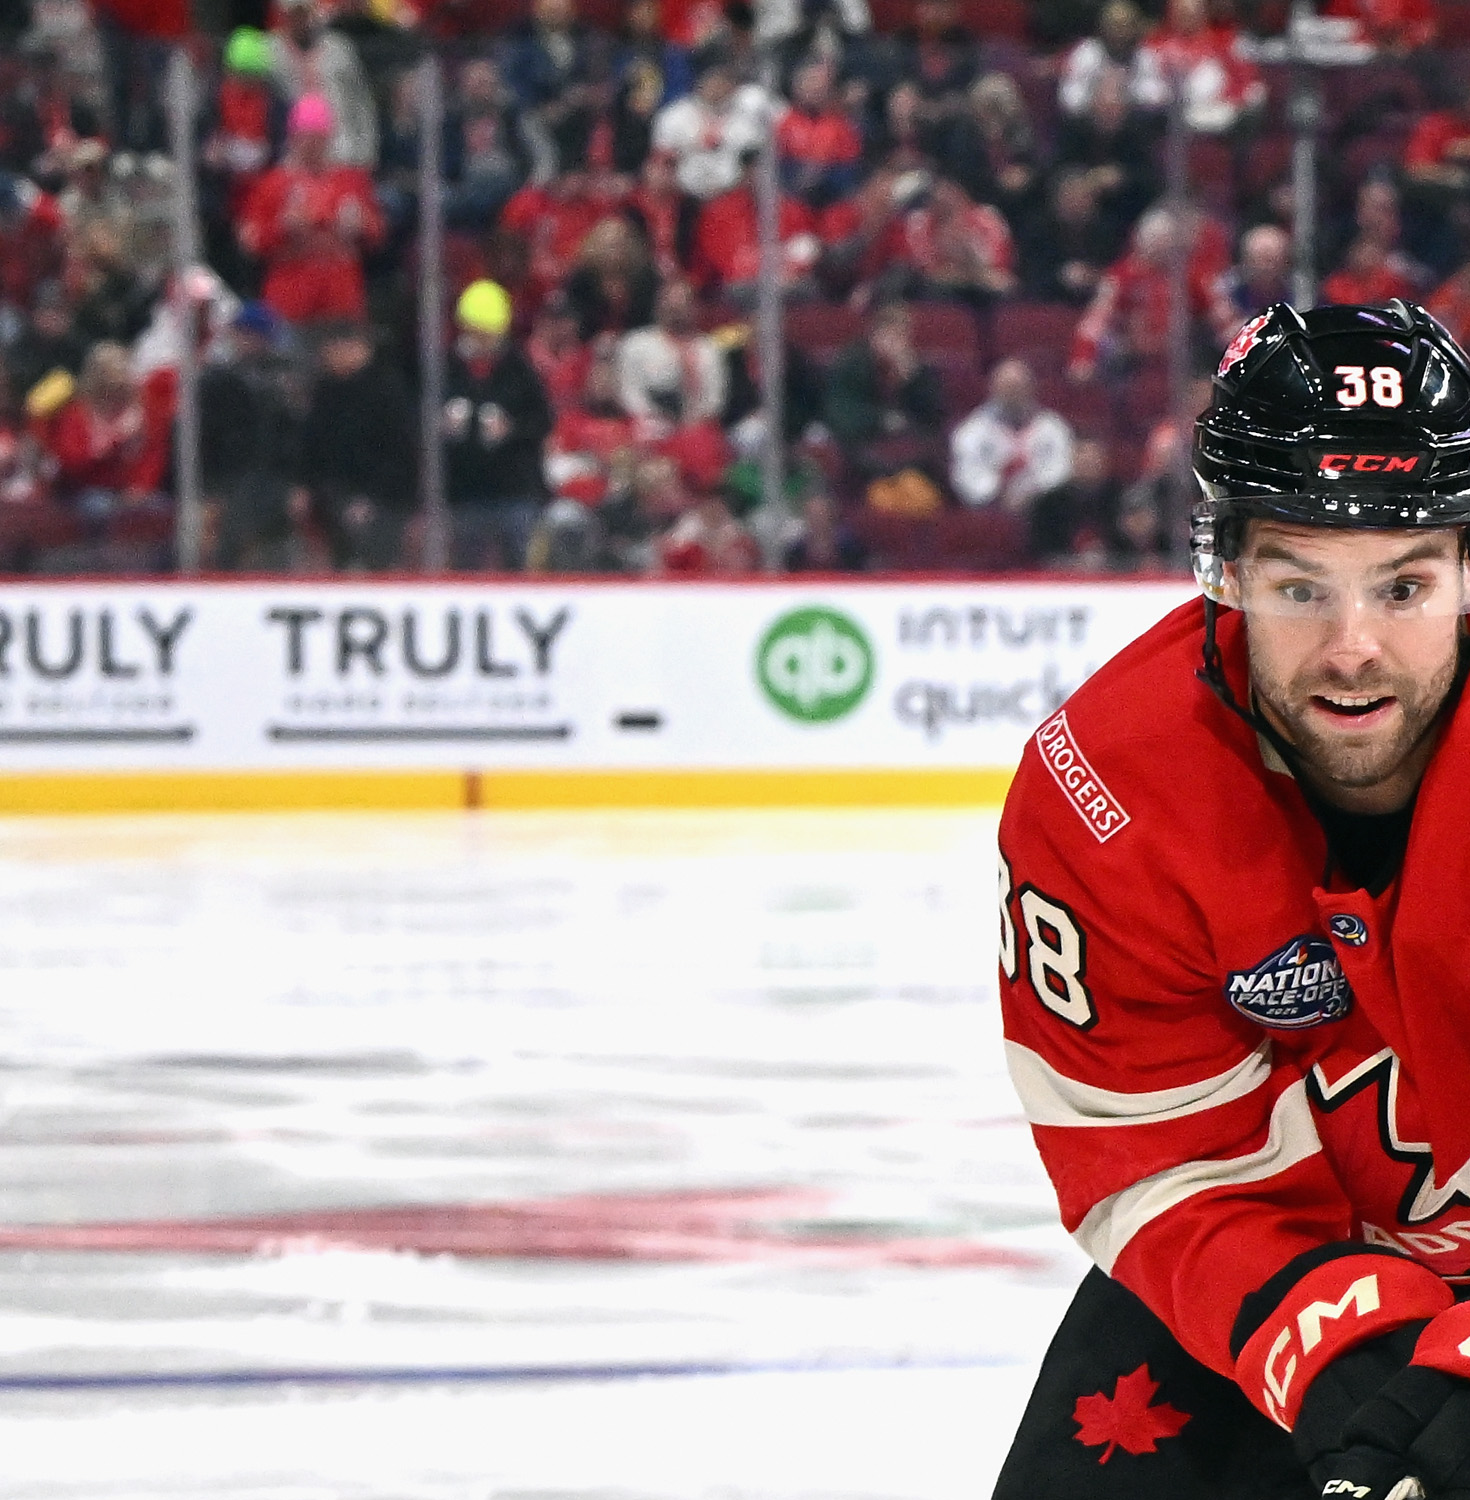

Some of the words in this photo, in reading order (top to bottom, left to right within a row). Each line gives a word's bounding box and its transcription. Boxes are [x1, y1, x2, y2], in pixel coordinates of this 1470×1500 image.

[1333, 365, 1404, 408] 38
[1318, 453, 1420, 473] CCM
[0, 608, 194, 680] ULY
[265, 606, 570, 680] TRULY
[1045, 734, 1120, 831] ROGERS
[1229, 958, 1346, 992] NATION
